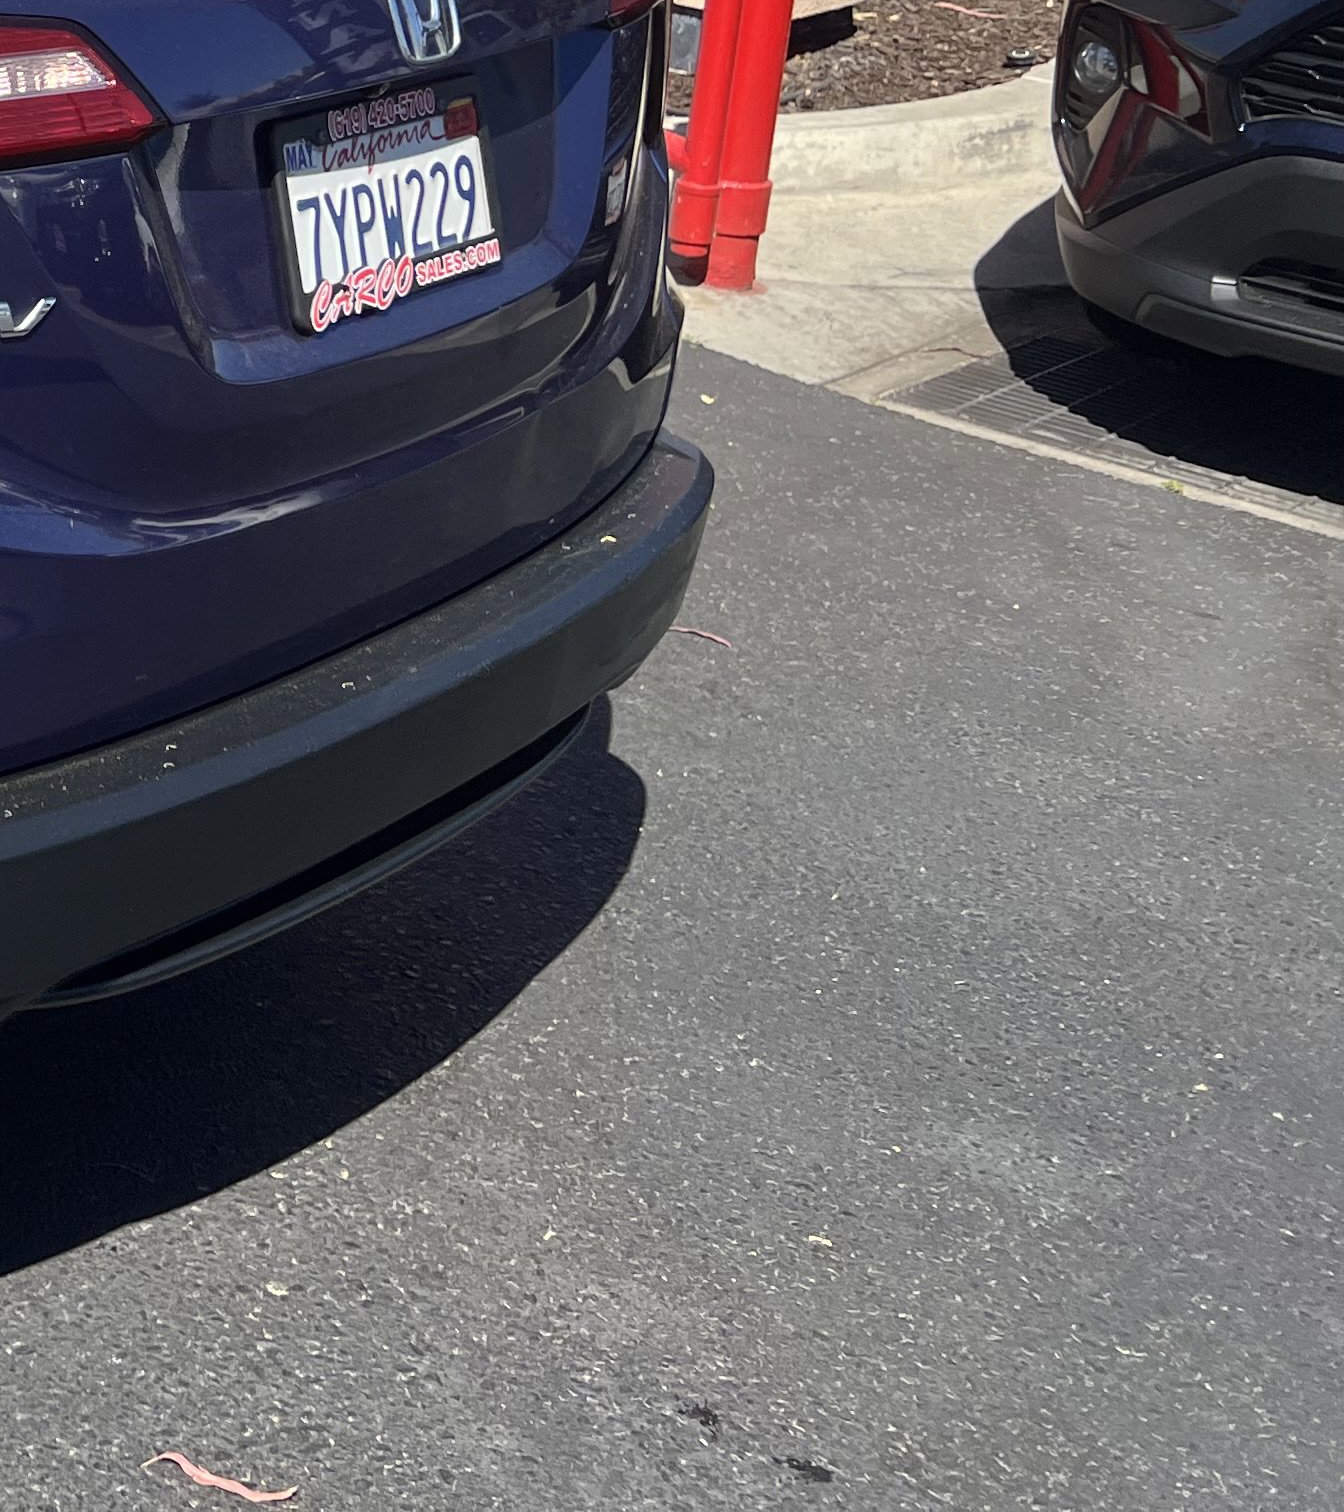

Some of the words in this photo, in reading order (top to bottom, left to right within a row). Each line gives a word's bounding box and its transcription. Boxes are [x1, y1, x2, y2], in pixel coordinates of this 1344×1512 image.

[285, 140, 316, 171] MAY
[322, 118, 446, 175] California
[296, 154, 476, 285] 7YPW229
[310, 254, 413, 333] CARCO
[415, 239, 501, 286] SALES.COM
